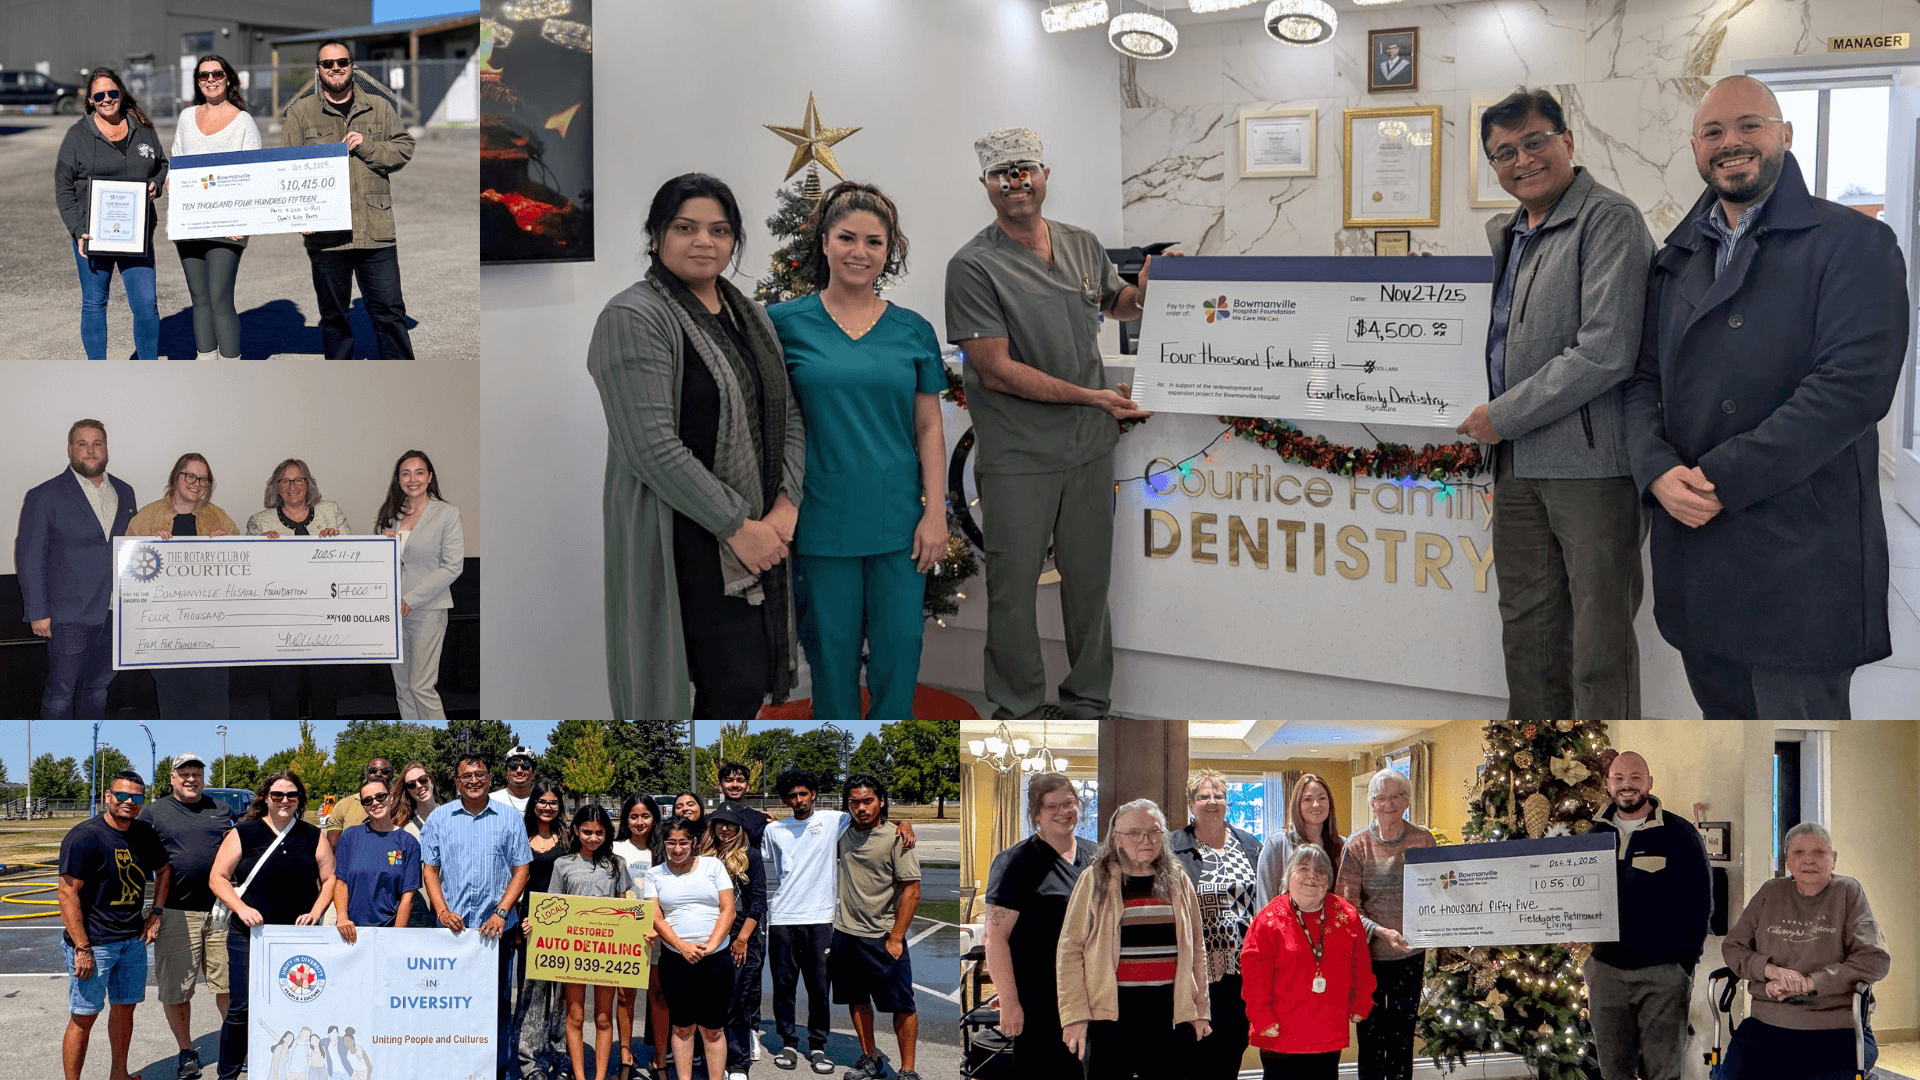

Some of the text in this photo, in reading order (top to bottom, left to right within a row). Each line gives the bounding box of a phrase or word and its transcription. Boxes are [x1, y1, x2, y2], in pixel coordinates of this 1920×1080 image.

[1833, 36, 1902, 49] MANAGER
[313, 161, 329, 169] 2025
[280, 177, 335, 191] $10,415.00
[182, 195, 317, 211] TEN THOUSAND FOUR HUNDRED FIFTEEN
[1233, 299, 1296, 308] Bowmanville
[1161, 341, 1335, 370] Four thousand five hundred
[1389, 386, 1449, 414] Dentistry
[1365, 404, 1397, 412] Signature
[1144, 457, 1494, 531] Courtice Family
[167, 551, 251, 563] THE ROTARY CLUB OF
[312, 548, 361, 562] 2025-11-19
[1144, 508, 1494, 593] DENTISTRY
[166, 565, 252, 577] COURTICE
[154, 585, 221, 599] BOWMANVILLE
[264, 582, 309, 597] FOUNDATION
[331, 582, 337, 599] $
[141, 608, 226, 623] FOUR THOUSAND
[138, 639, 157, 649] FILM
[1549, 860, 1563, 868] Dec
[1458, 870, 1498, 878] Bowmanville
[541, 904, 565, 920] LOCAL
[1419, 904, 1436, 916] one
[1439, 901, 1483, 914] thousand
[1516, 898, 1538, 910] five
[1519, 911, 1603, 925] Fieldgate Retirement
[566, 926, 614, 938] RESTORED
[1546, 922, 1572, 931] Living
[536, 936, 642, 957] AUTO DETAILING
[301, 956, 323, 977] DIVERSITY
[407, 957, 457, 970] UNITY
[535, 953, 640, 976] (289) 939-2425
[390, 996, 472, 1009] DIVERSITY
[372, 1035, 489, 1045] Uniting People and Cultures
